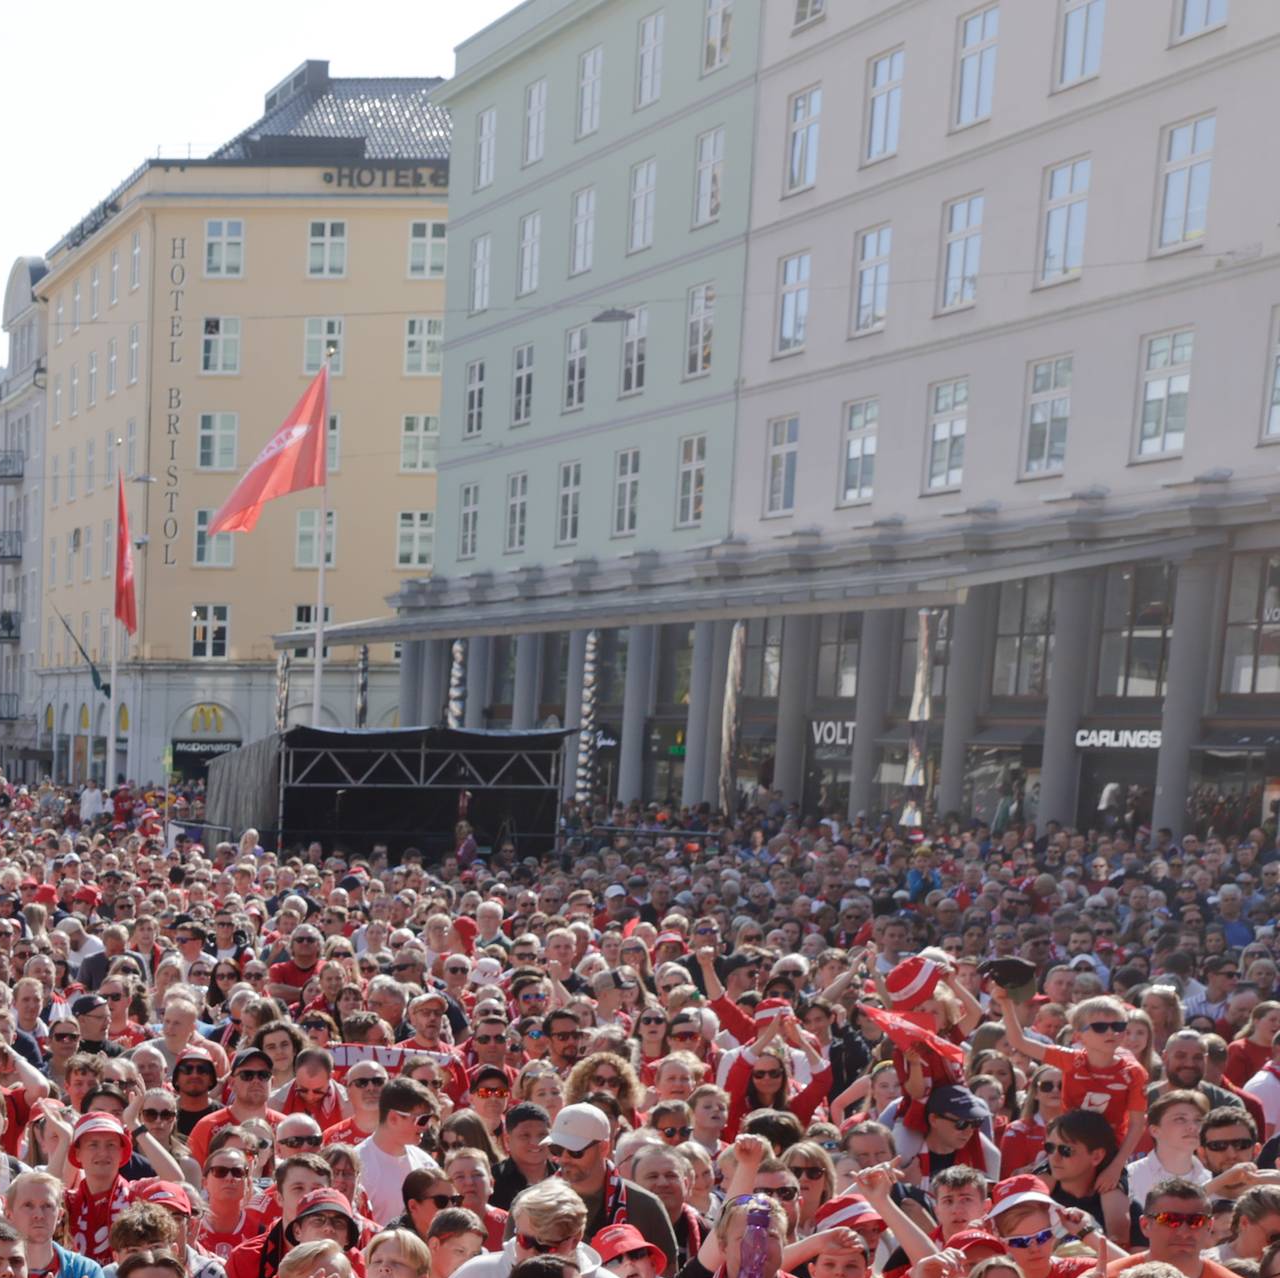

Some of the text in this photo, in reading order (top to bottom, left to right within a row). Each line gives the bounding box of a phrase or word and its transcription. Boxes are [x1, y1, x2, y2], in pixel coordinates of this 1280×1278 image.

[335, 166, 426, 188] HOTEL
[163, 237, 186, 567] HOTEL BRISTOL
[812, 721, 857, 744] VOLT
[1075, 730, 1163, 748] CARLINGS
